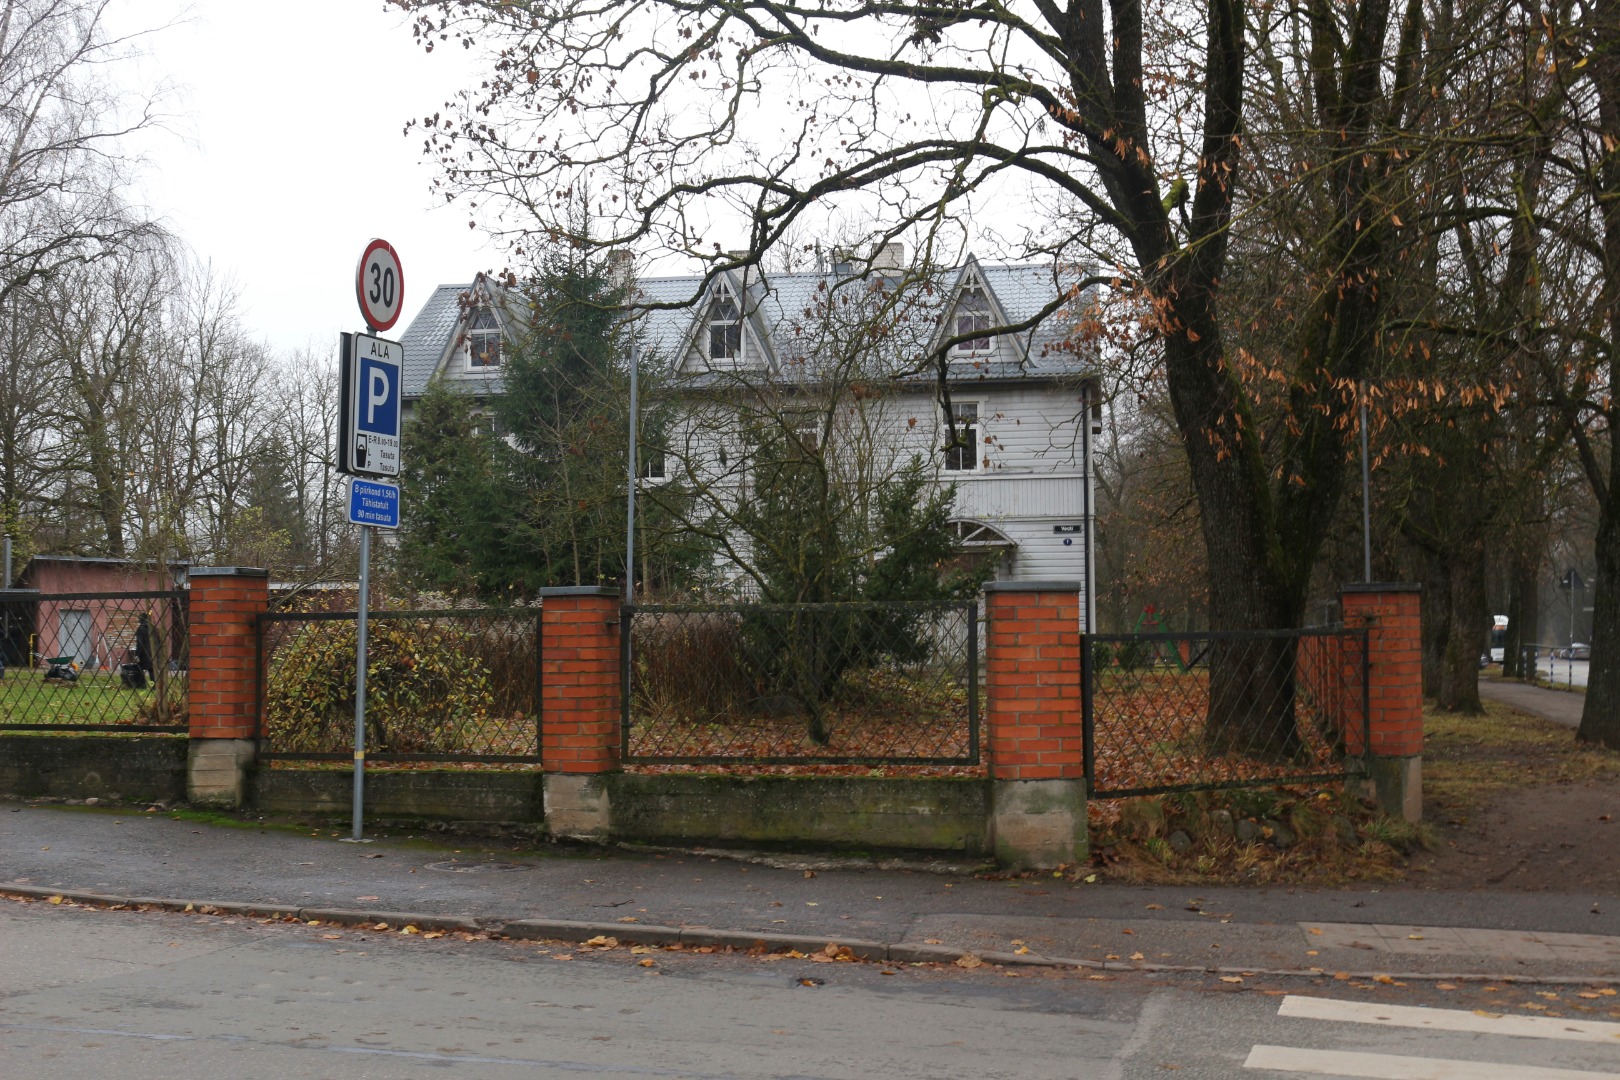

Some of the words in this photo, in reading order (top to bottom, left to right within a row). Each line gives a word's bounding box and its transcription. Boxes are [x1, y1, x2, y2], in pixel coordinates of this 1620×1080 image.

[370, 262, 394, 308] 30
[370, 342, 390, 360] ALA
[367, 366, 390, 424] P
[380, 450, 395, 460] Tasuta
[367, 460, 371, 469] P
[379, 462, 395, 472] Tasuta
[362, 497, 389, 510] Tähistatult
[357, 509, 365, 518] 90
[365, 511, 375, 520] min
[375, 512, 392, 522] tasuta
